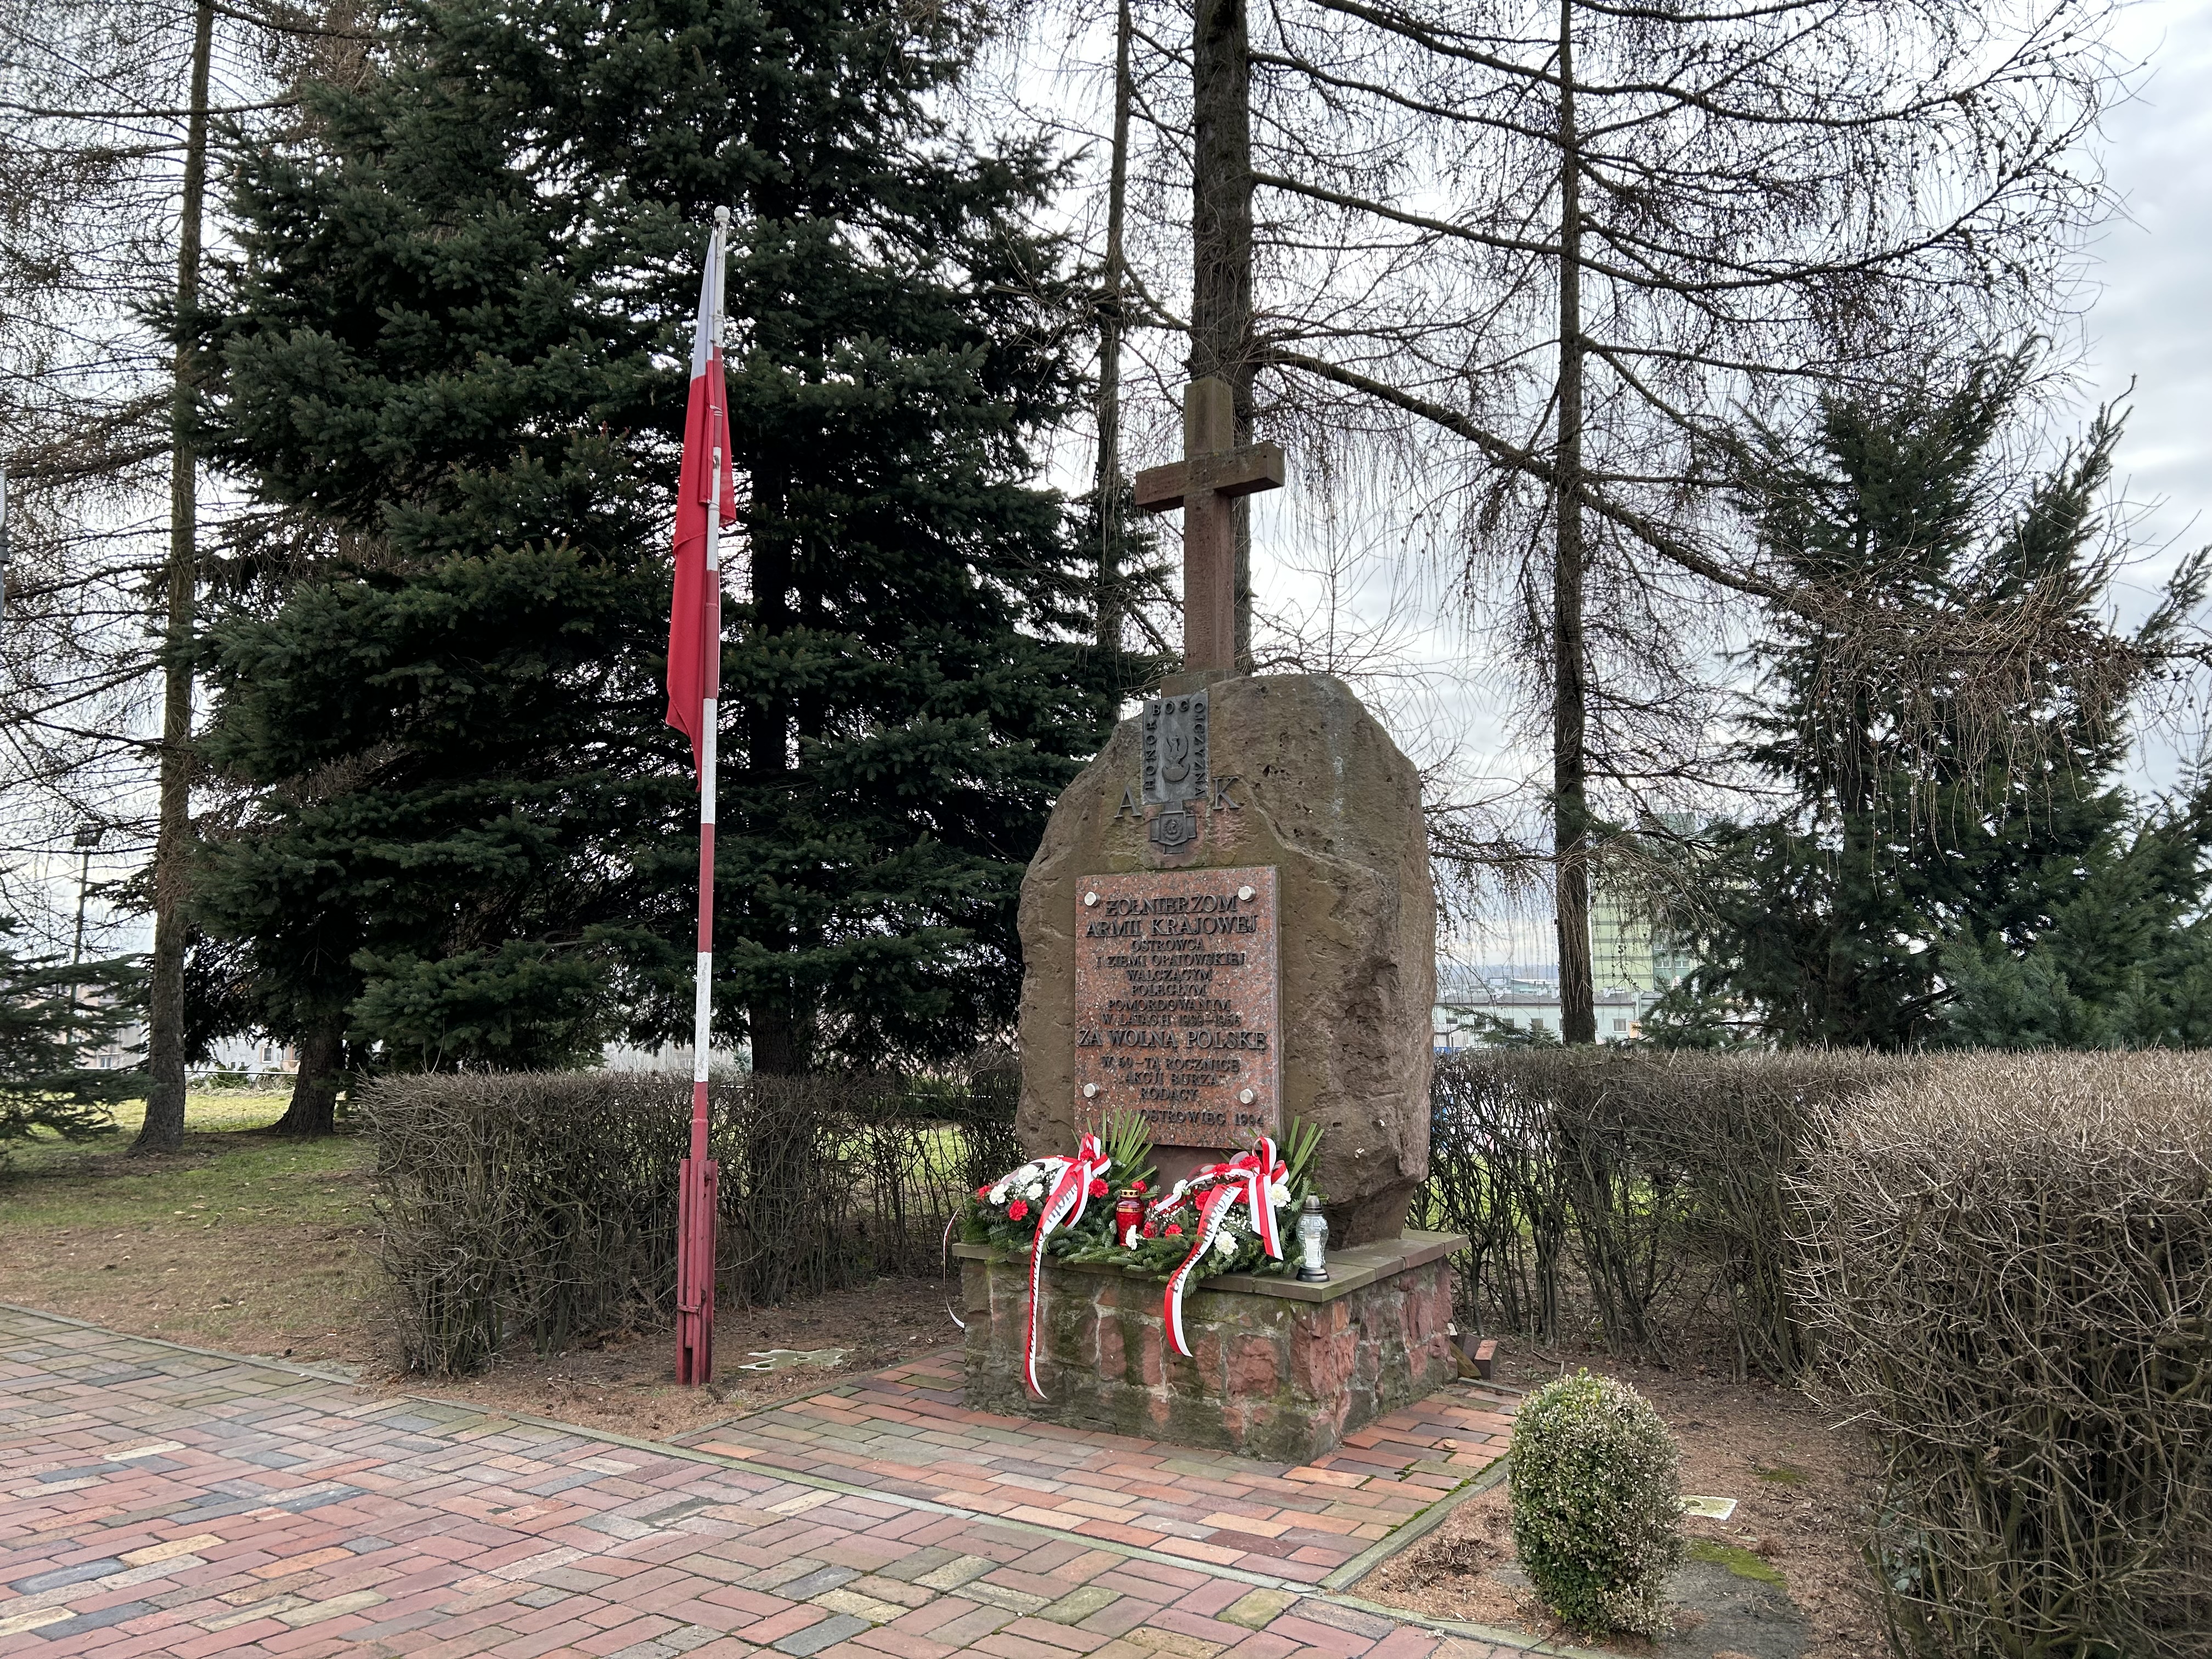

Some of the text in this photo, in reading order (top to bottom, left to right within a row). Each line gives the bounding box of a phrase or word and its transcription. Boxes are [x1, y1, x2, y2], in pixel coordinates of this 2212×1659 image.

[1145, 719, 1157, 791] HONOR
[1114, 776, 1240, 819] A K
[1086, 915, 1258, 938] ARMII KRAJOWEJ
[1131, 938, 1205, 952] OSTROWCA
[1097, 952, 1245, 967] I ZIEMI OPATOWSKIEJ
[1131, 984, 1208, 996] POLEGŁYM
[1108, 998, 1231, 1011] POMORDOWANYM
[1101, 1013, 1113, 1025] W
[1119, 1013, 1171, 1026] LATACH
[1078, 1029, 1268, 1054] ZA WOLNĄ POLSKĘ
[1102, 1056, 1114, 1068] W
[1140, 1086, 1200, 1100] RODACY
[1140, 1109, 1264, 1127] OSTROWIEC 1994
[1045, 1175, 1078, 1223] owiatu
